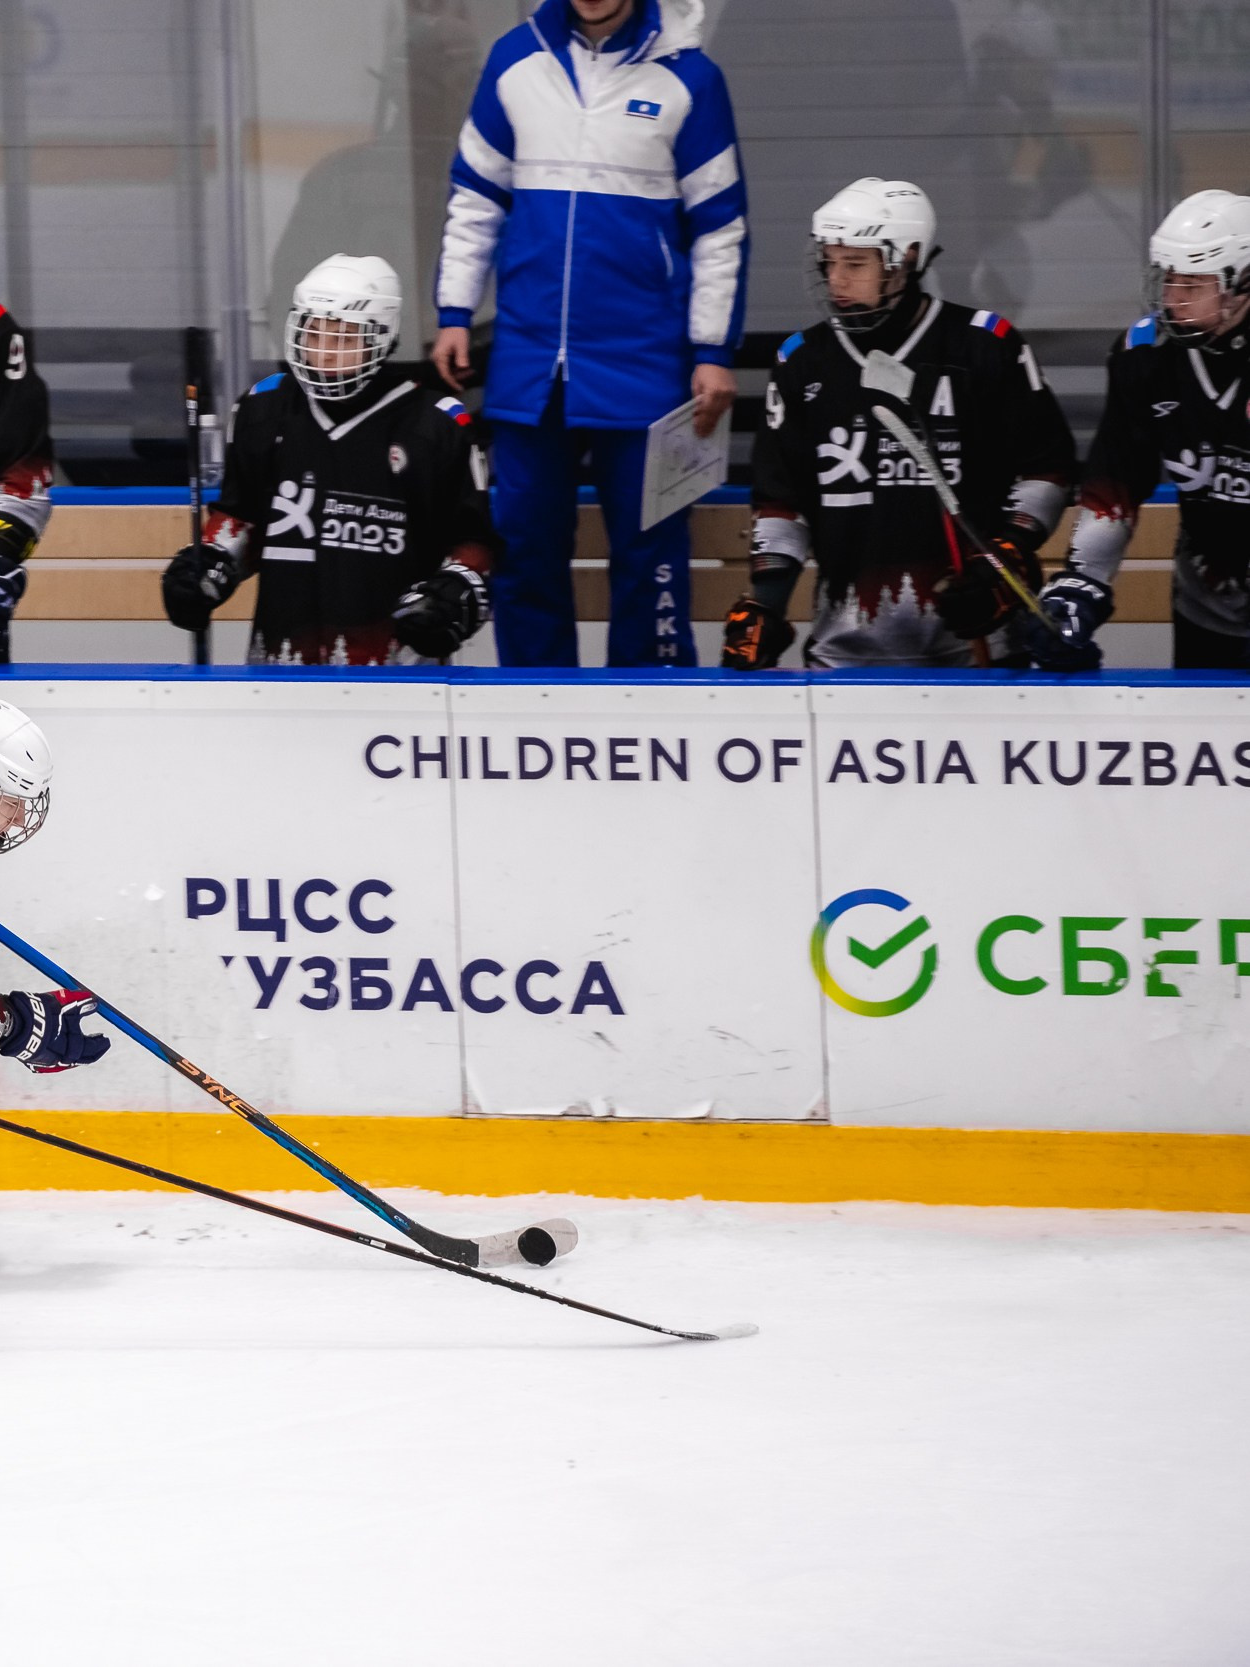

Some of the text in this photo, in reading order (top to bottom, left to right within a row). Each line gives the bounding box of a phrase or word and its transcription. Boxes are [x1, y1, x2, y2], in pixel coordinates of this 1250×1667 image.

[929, 375, 955, 416] A
[320, 518, 406, 555] 2023
[654, 563, 679, 668] SAKH
[364, 734, 688, 782] CHILDREN
[717, 737, 803, 783] OF
[827, 739, 977, 785] ASIA
[220, 955, 626, 1016] УЗБАССА
